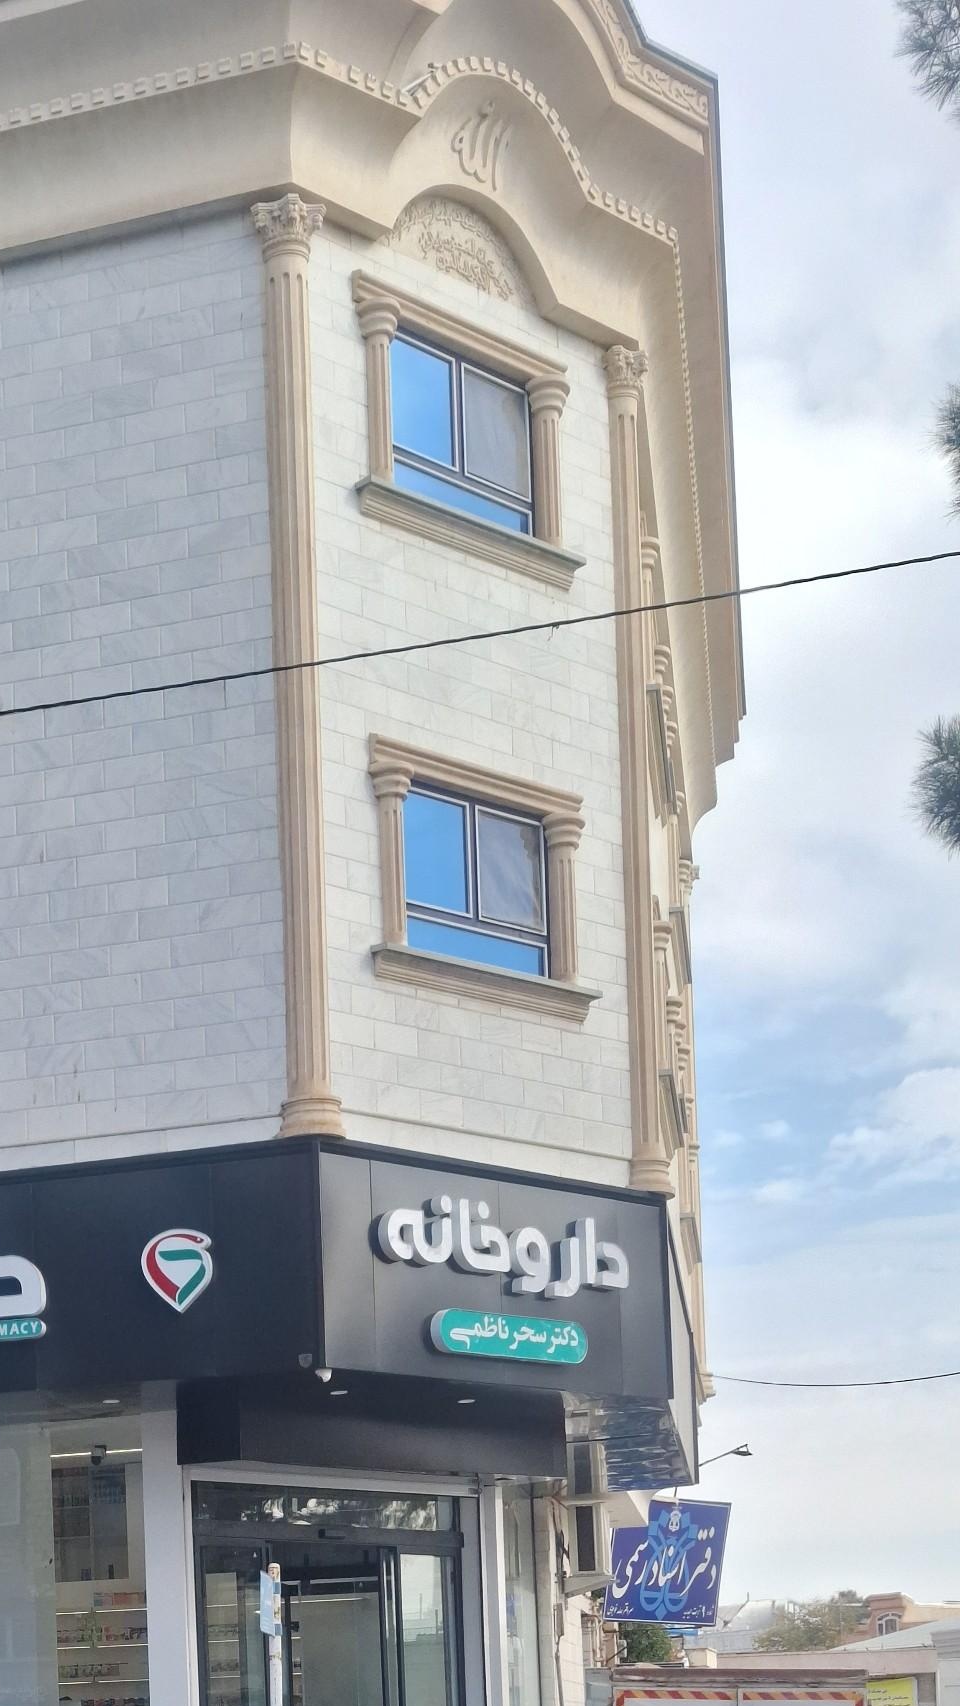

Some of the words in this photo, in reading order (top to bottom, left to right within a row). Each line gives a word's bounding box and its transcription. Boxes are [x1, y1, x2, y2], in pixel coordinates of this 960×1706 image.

[378, 1195, 629, 1298] داروخانه
[449, 1315, 509, 1350] ناظمی
[509, 1325, 547, 1350] سحر
[547, 1325, 579, 1354] دکتر
[679, 1526, 717, 1597] دفتر
